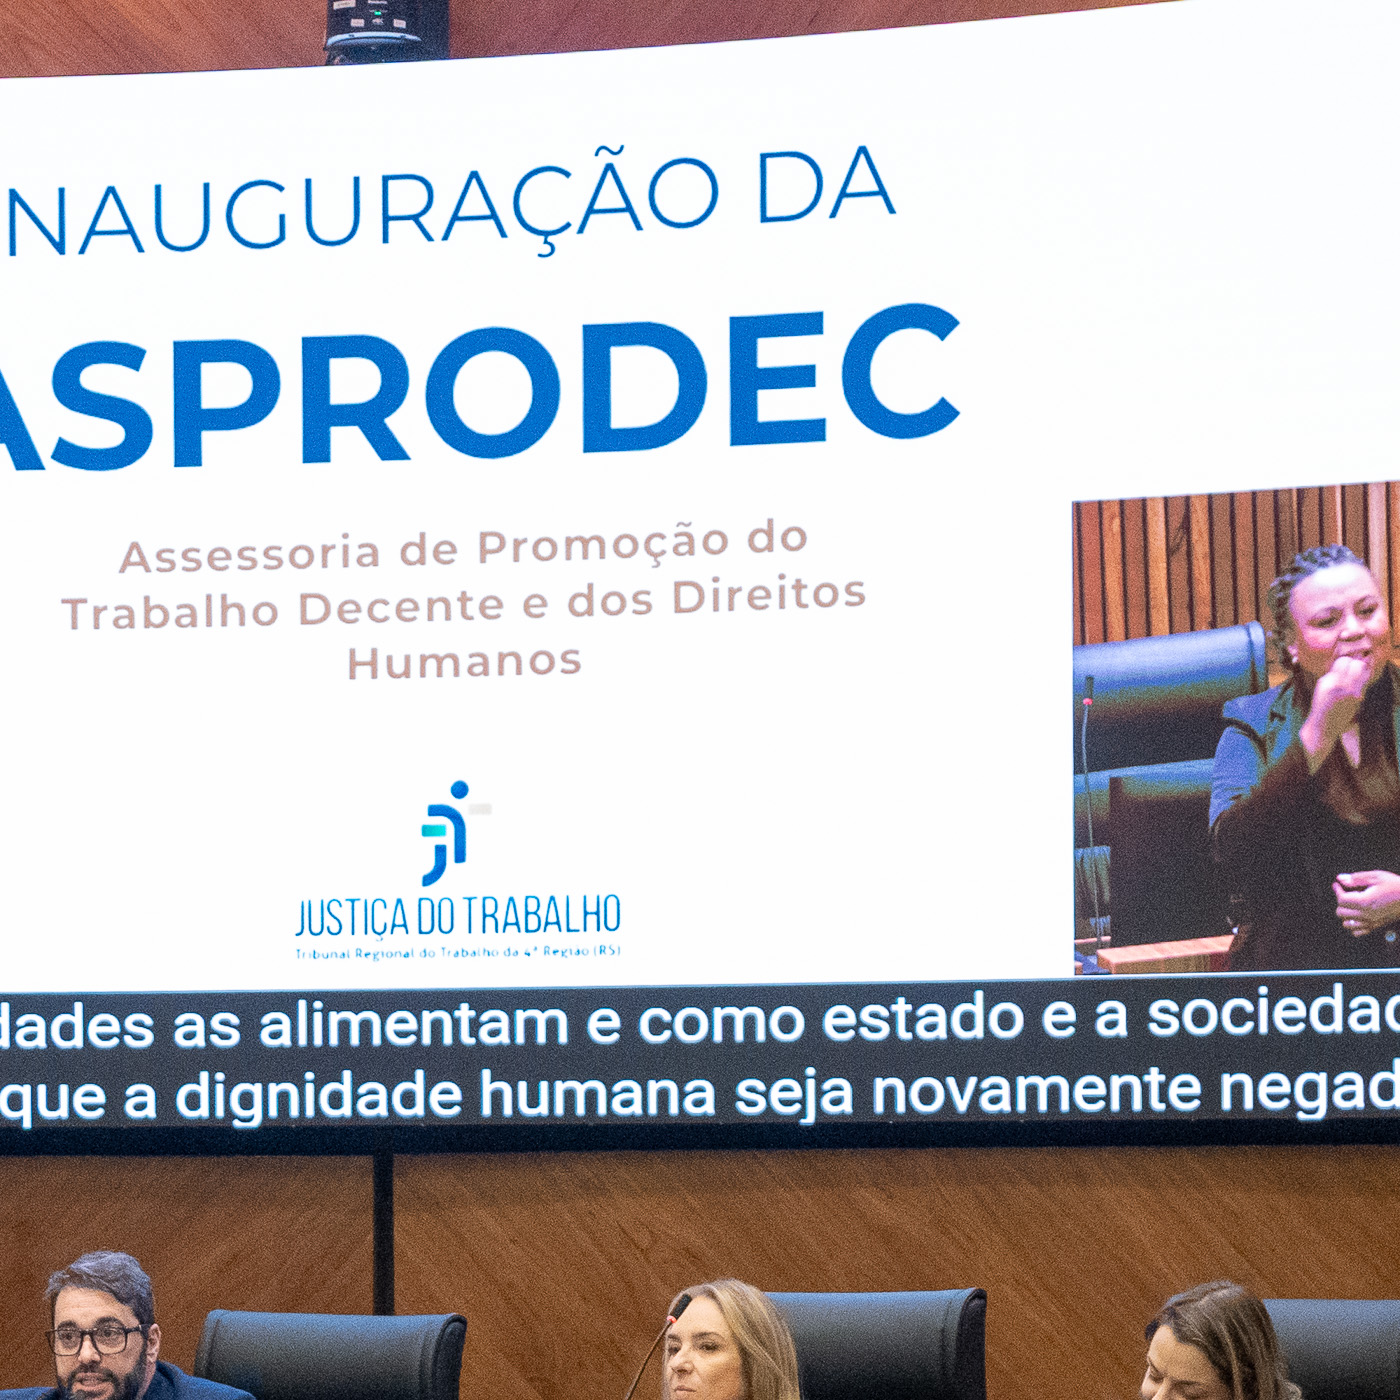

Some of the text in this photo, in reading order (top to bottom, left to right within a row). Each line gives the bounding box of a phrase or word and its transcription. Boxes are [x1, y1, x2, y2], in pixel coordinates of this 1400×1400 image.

[760, 146, 896, 223] DA
[119, 519, 807, 573] Assessoria de Promoção do
[61, 574, 865, 629] Trabalho Decente e dos Direitos
[350, 648, 580, 679] Humanos
[296, 895, 620, 940] JUSTIÇA DO TRABALHO
[356, 948, 414, 962] Regional
[420, 948, 435, 958] do
[442, 947, 499, 958] Trabalho
[503, 947, 518, 957] da
[594, 945, 620, 956] (RS)
[175, 1013, 240, 1047] as
[261, 1000, 567, 1046] alimentam
[588, 1009, 620, 1043] e
[640, 1006, 804, 1043] como
[825, 991, 1023, 1040] estado
[1044, 1002, 1076, 1037] e
[1097, 1001, 1127, 1036] a
[0, 1084, 105, 1128] que
[125, 1084, 156, 1118] a
[177, 1070, 462, 1127] dignidade
[482, 1069, 715, 1115] humana
[737, 1067, 852, 1123] seja
[875, 1067, 1200, 1113] novamente
